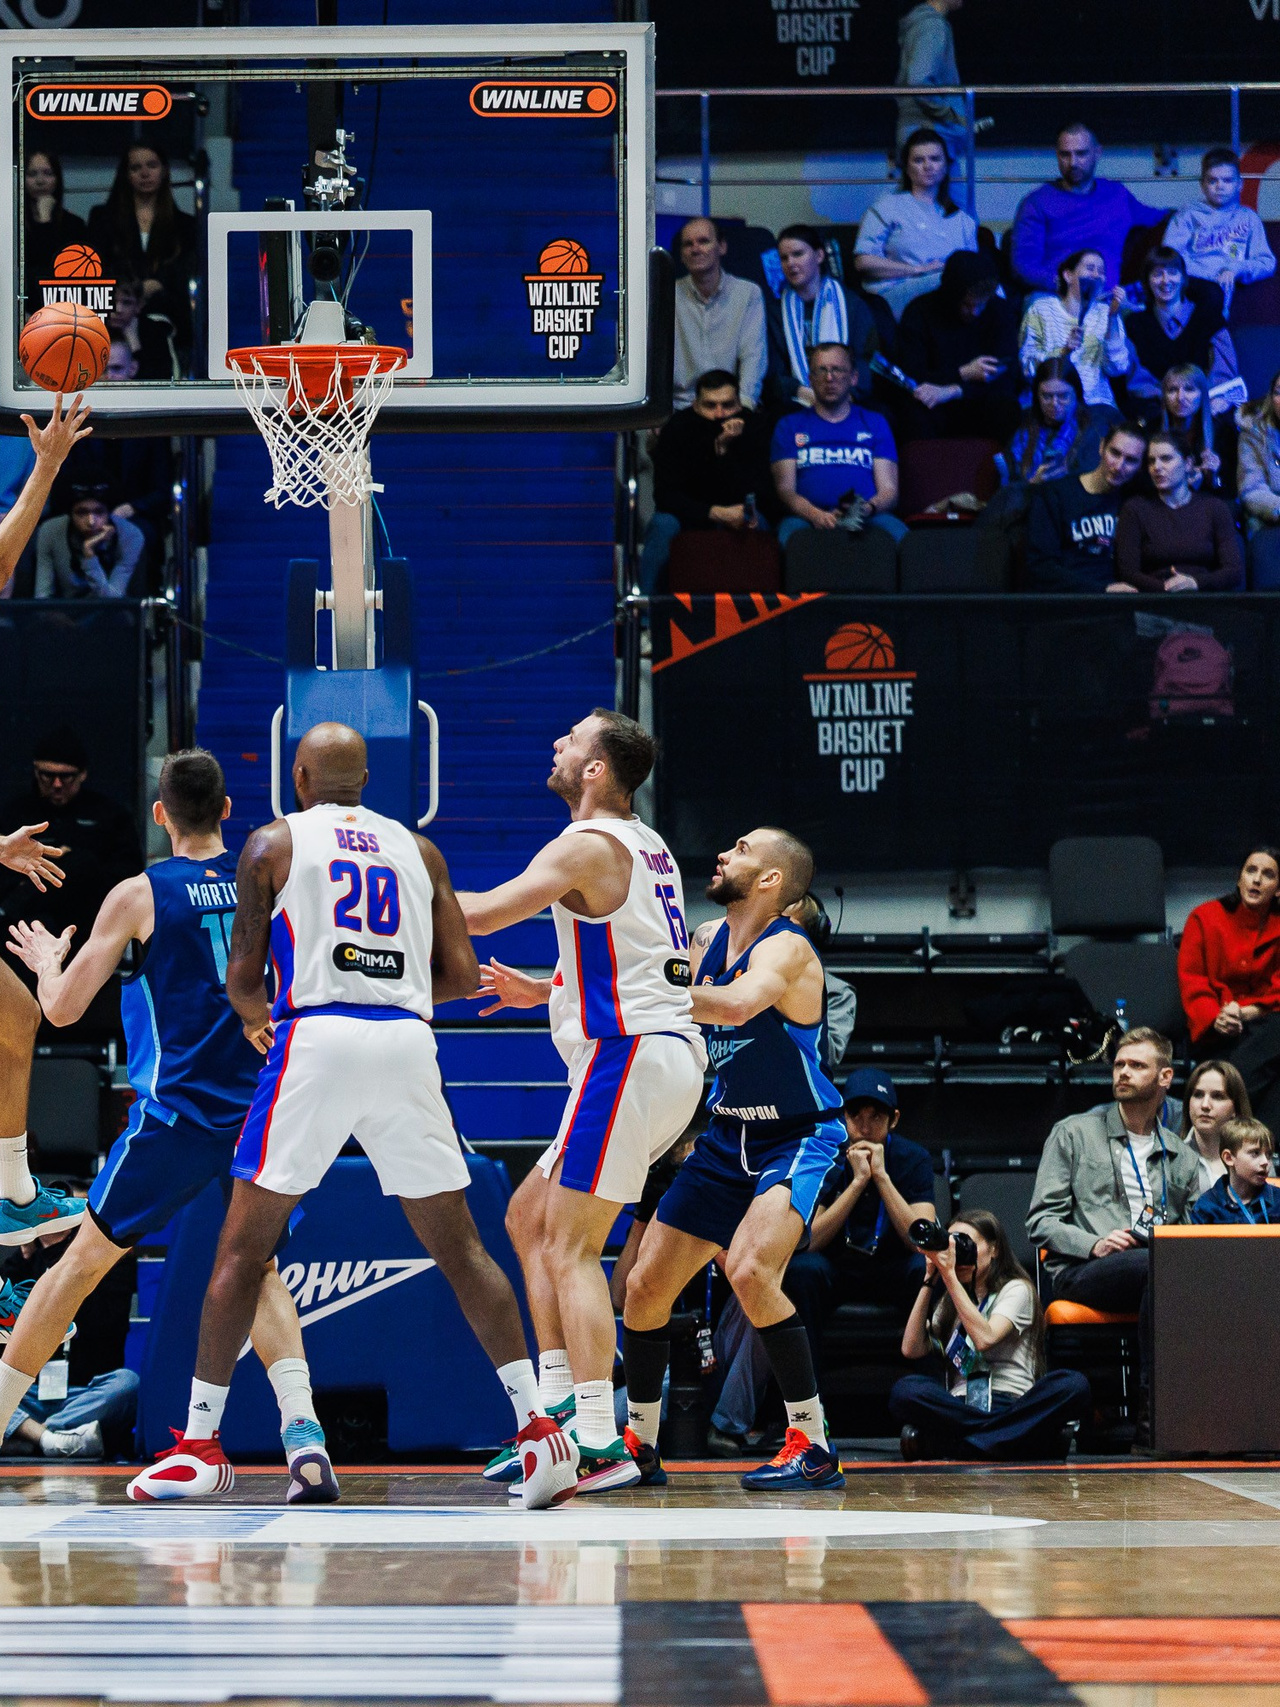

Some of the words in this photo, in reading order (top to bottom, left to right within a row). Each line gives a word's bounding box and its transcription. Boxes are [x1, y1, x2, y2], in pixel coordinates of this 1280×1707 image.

[777, 13, 853, 43] BASKET
[796, 45, 836, 76] CUP
[38, 92, 140, 113] WINLINE
[477, 89, 584, 110] WINLINE
[528, 282, 600, 306] WINLINE
[533, 309, 594, 333] BASKET
[548, 335, 580, 359] CUP
[1071, 513, 1119, 542] LOND
[808, 681, 914, 717] WINLINE
[817, 720, 906, 755] BASKET
[840, 757, 885, 793] CUP
[334, 828, 381, 853] BESS
[329, 859, 401, 937] 20
[655, 883, 690, 951] 15
[344, 947, 398, 969] OPTIMA
[275, 1255, 438, 1330] енит
